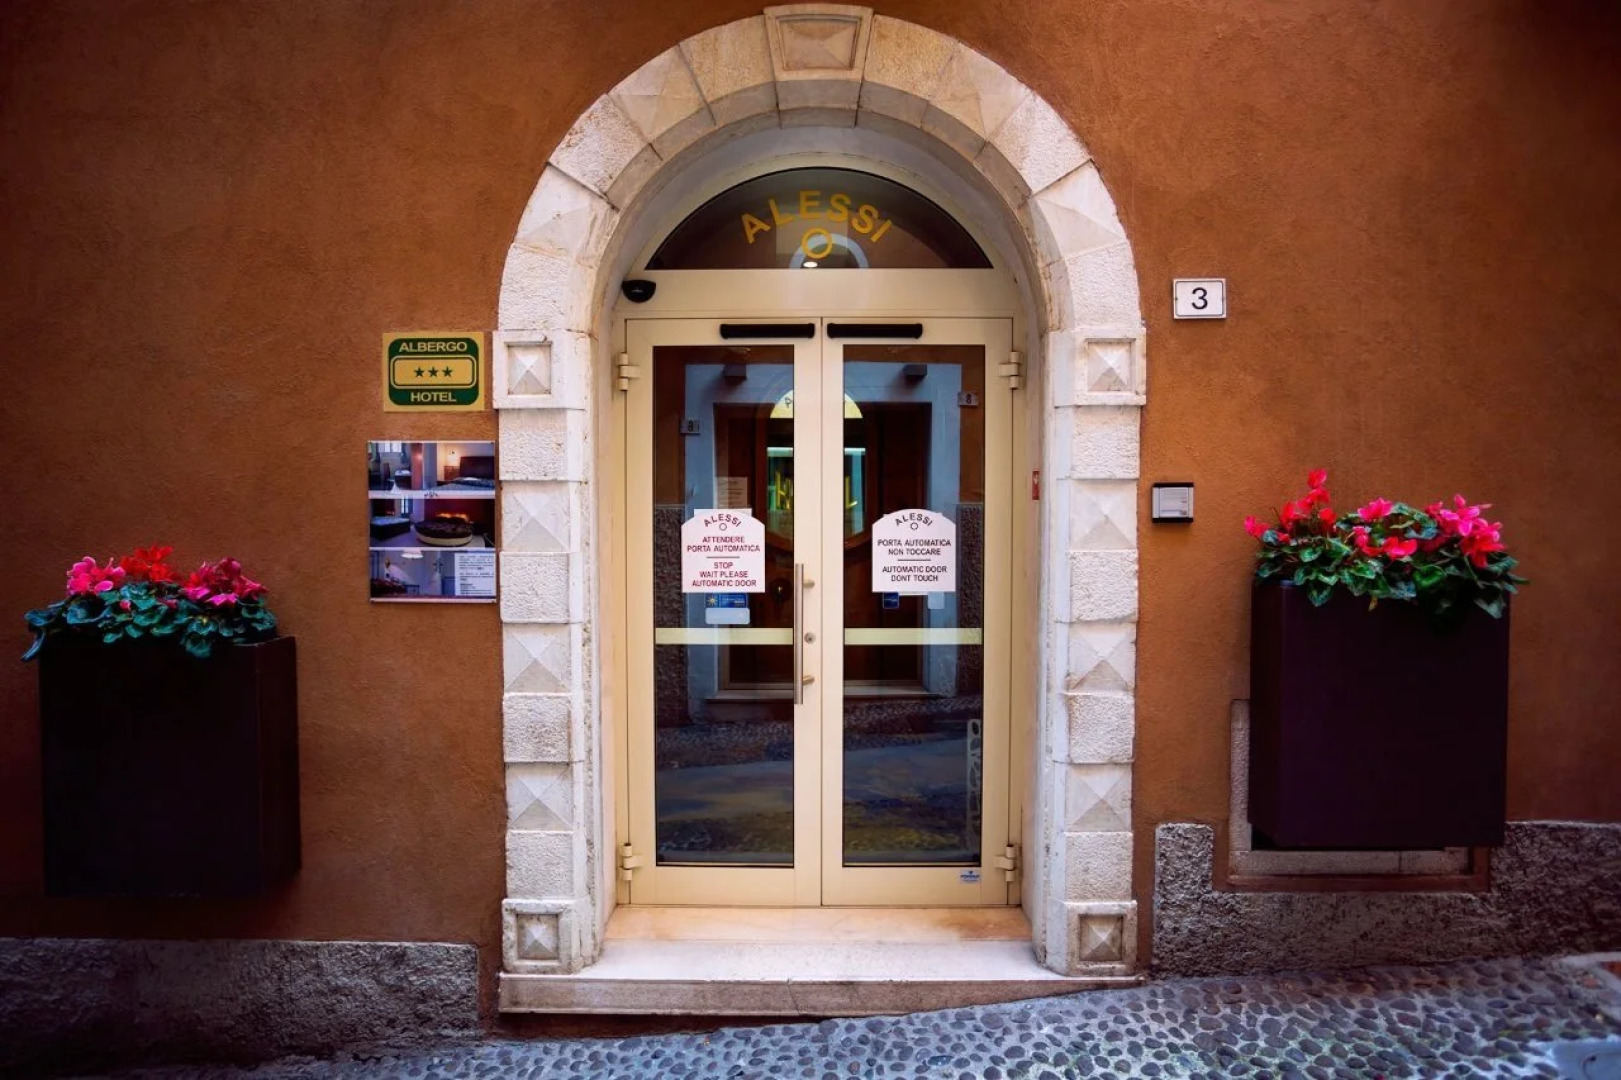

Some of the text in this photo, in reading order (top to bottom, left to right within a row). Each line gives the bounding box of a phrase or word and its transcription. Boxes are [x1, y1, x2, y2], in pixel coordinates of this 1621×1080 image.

[741, 190, 892, 243] ALESSI
[1192, 287, 1208, 310] 3
[399, 342, 468, 352] ALBERGO
[410, 392, 456, 402] HOTEL
[704, 514, 742, 527] ALESSI
[896, 512, 932, 526] ALESSI
